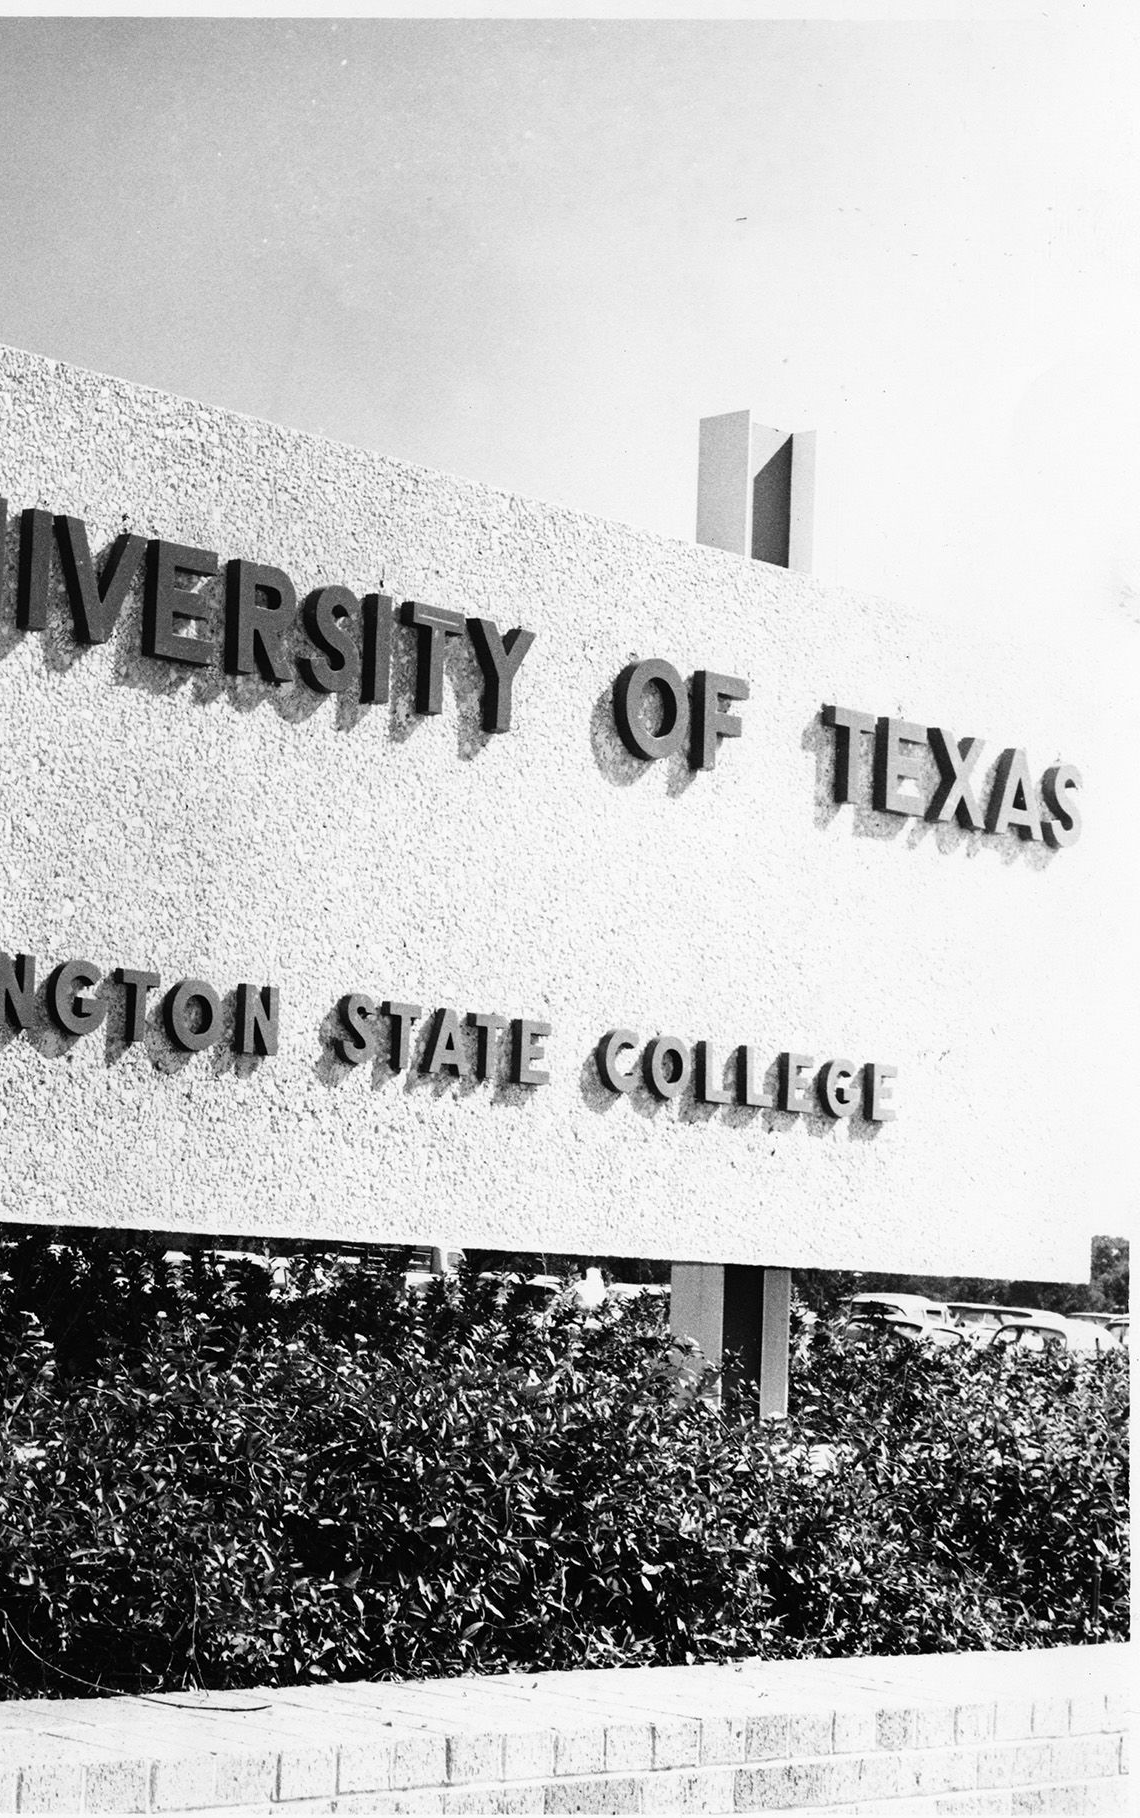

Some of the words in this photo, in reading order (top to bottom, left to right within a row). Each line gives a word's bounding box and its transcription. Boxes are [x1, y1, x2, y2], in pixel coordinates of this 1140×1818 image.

[612, 658, 749, 771] OF
[822, 704, 1083, 848] TEXAS
[336, 993, 551, 1086] STATE
[597, 1029, 897, 1121] COLLEGE
